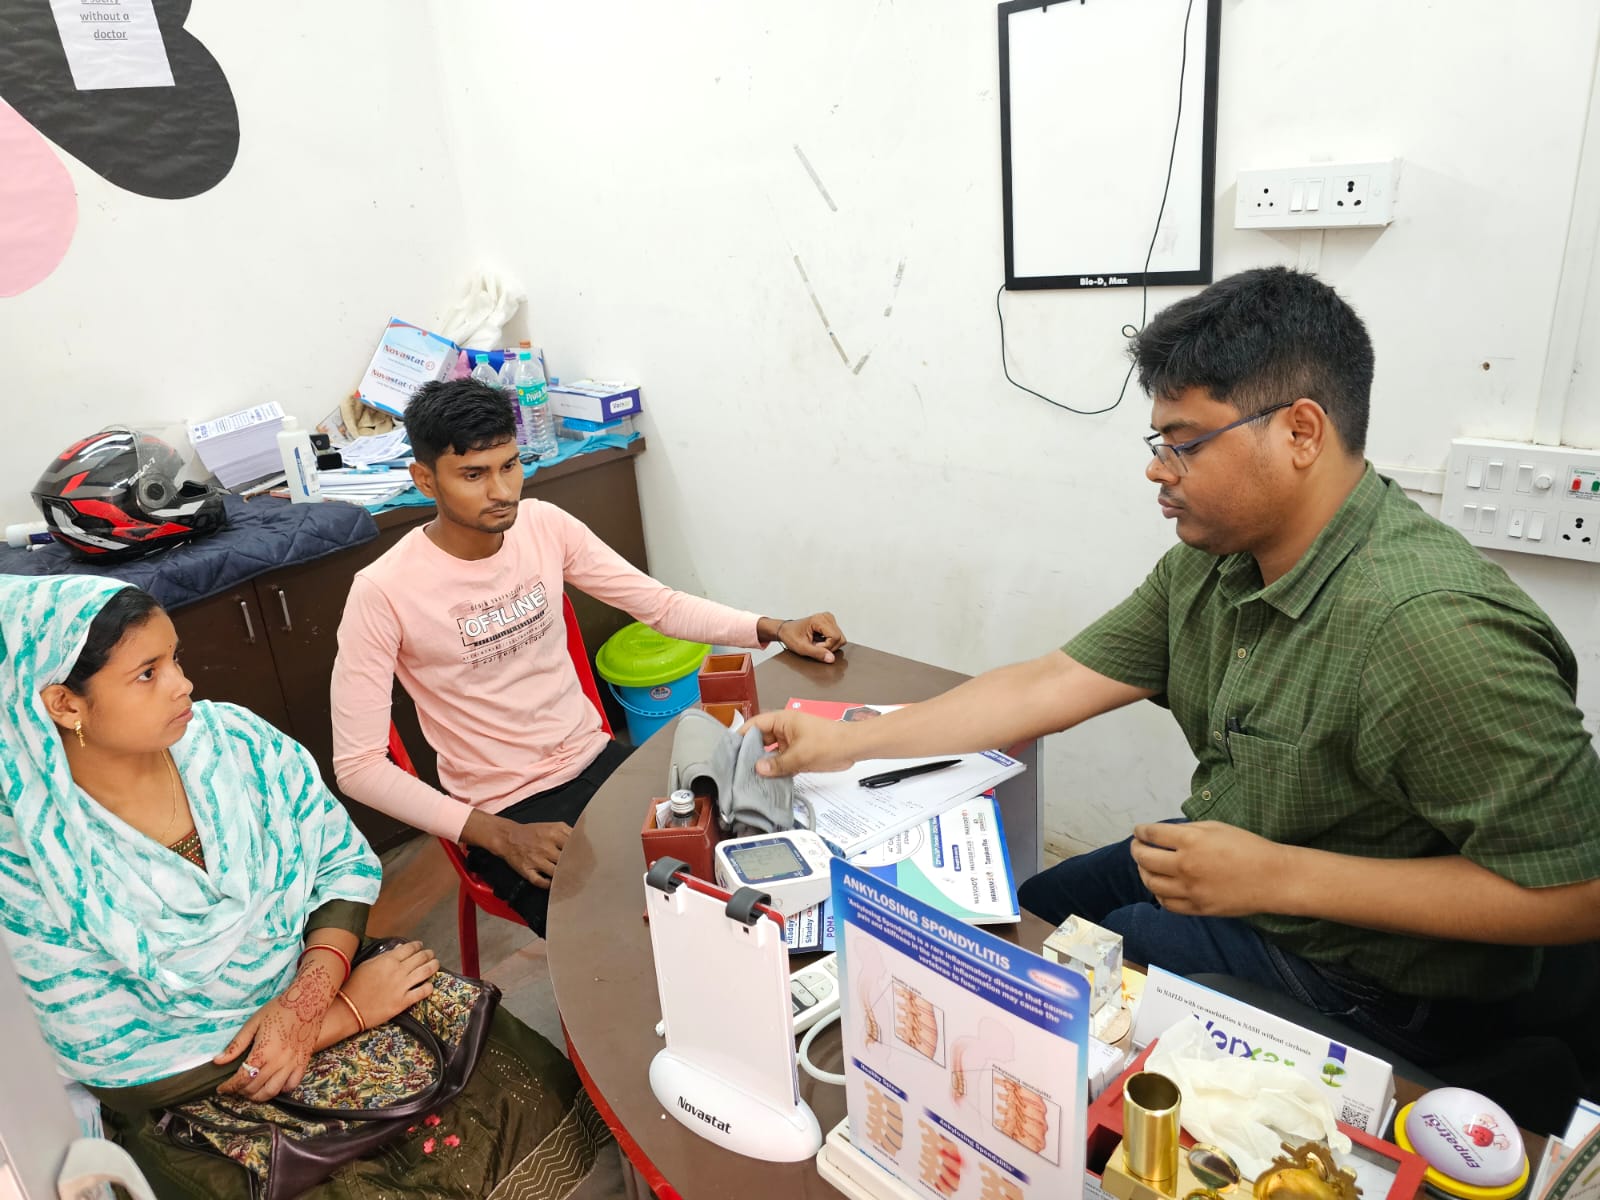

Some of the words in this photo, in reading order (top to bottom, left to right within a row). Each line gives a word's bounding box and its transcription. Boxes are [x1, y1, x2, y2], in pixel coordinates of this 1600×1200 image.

[80, 11, 120, 21] without
[123, 13, 130, 21] a
[93, 29, 127, 39] doctor
[1108, 276, 1129, 285] Max
[384, 344, 425, 366] Novastat
[464, 586, 546, 638] OFFLINE
[805, 918, 814, 944] Sitaday
[843, 873, 919, 924] ANKYLOSING
[920, 915, 1011, 971] SPONDYLITIS
[871, 918, 883, 931] and
[1001, 990, 1019, 1005] may
[1019, 999, 1044, 1017] cause
[1044, 1010, 1060, 1024] the
[918, 954, 951, 977] vertebrae
[951, 972, 960, 982] to
[993, 976, 1024, 998] disease
[1024, 991, 1042, 1006] that
[1043, 1000, 1074, 1021] causes
[1183, 998, 1196, 1008] with
[1242, 1021, 1261, 1036] NASH
[1261, 1030, 1285, 1045] without
[677, 1095, 732, 1135] Novastat
[939, 1118, 975, 1147] Ankylosing
